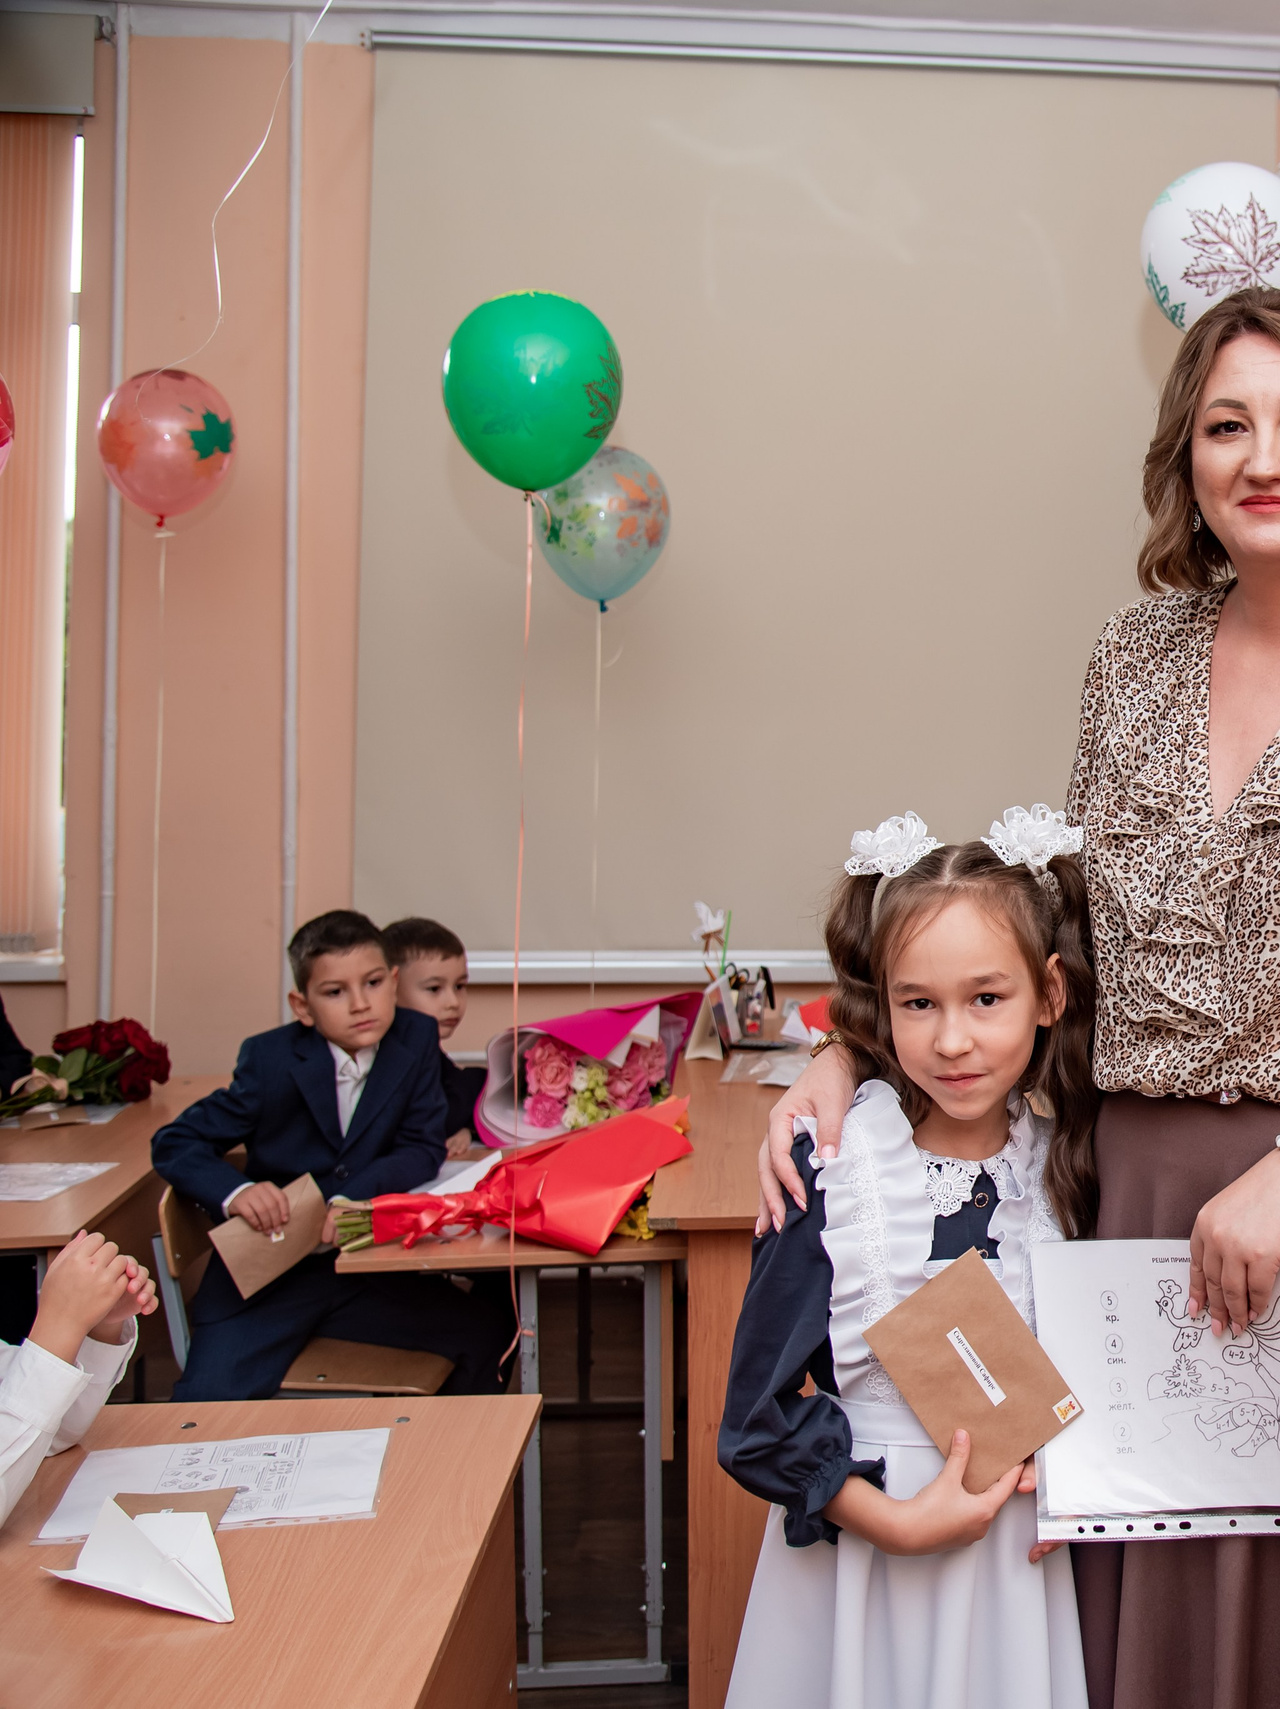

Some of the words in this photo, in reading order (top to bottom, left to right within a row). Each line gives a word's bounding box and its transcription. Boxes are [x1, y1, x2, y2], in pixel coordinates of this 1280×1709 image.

[1166, 1285, 1172, 1294] 5
[1106, 1296, 1113, 1306] 5
[1105, 1314, 1120, 1324] кр.
[1180, 1331, 1198, 1342] 1+3
[1110, 1338, 1117, 1348] 4
[1228, 1350, 1245, 1360] 4-2
[1116, 1382, 1122, 1392] 3
[1210, 1383, 1230, 1395] 5-3
[1108, 1400, 1135, 1412] жёлт.
[1239, 1407, 1256, 1417] 5-1
[1216, 1420, 1230, 1431] 4-1
[1262, 1418, 1276, 1427] 3+1
[1120, 1426, 1126, 1437] 2
[1116, 1446, 1136, 1454] зел.
